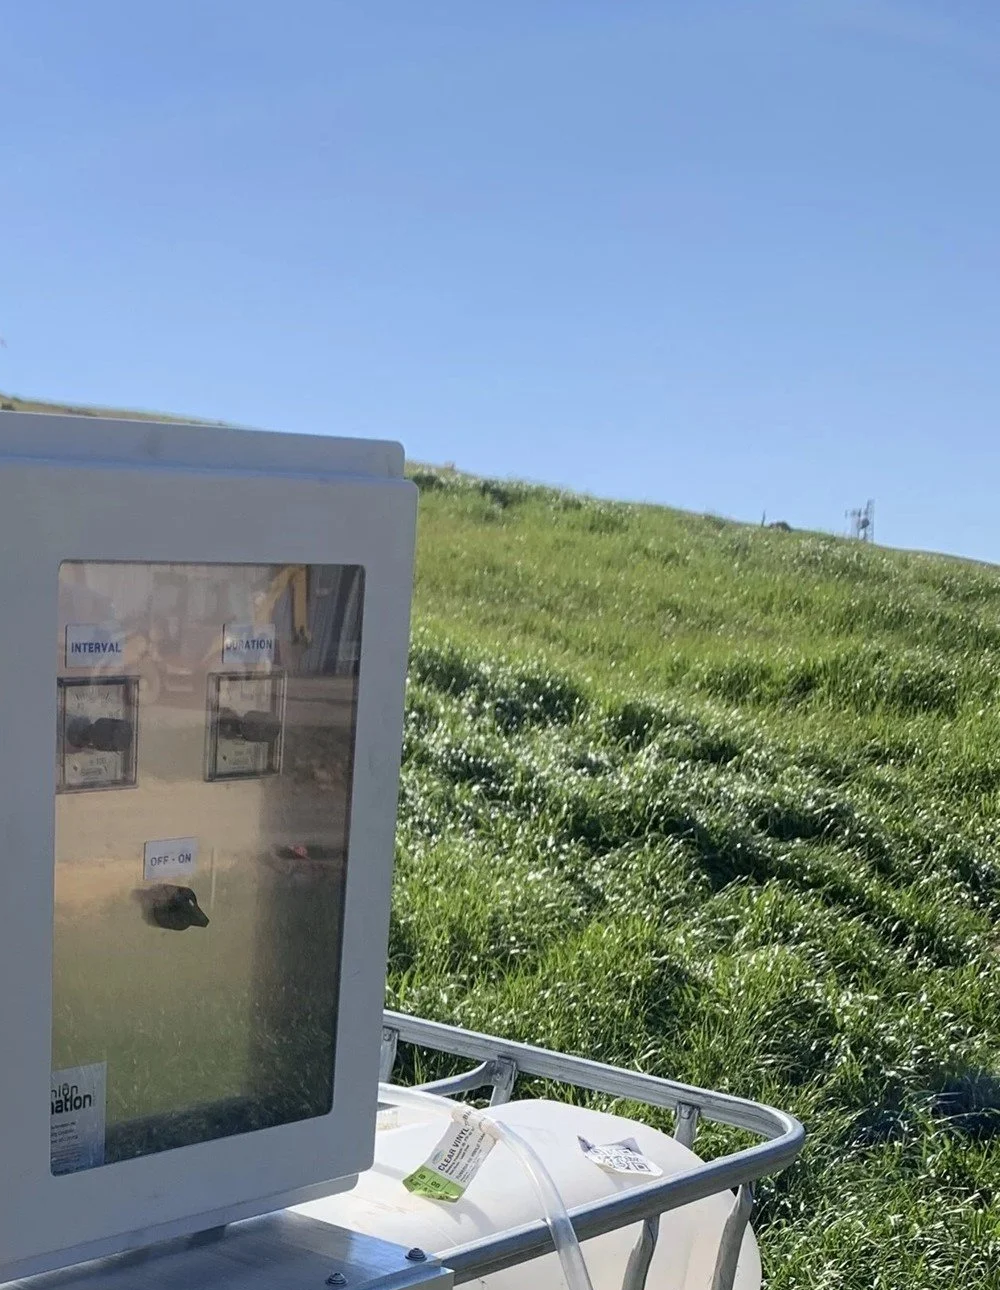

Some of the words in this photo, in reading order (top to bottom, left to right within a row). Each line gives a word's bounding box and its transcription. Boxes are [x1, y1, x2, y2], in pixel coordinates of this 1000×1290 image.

[71, 642, 122, 654] INTERVAL
[225, 639, 273, 651] DURATION
[150, 855, 169, 867] OFF
[178, 853, 192, 864] ON
[437, 1148, 457, 1172] CLEAR
[452, 1127, 469, 1149] VINYL
